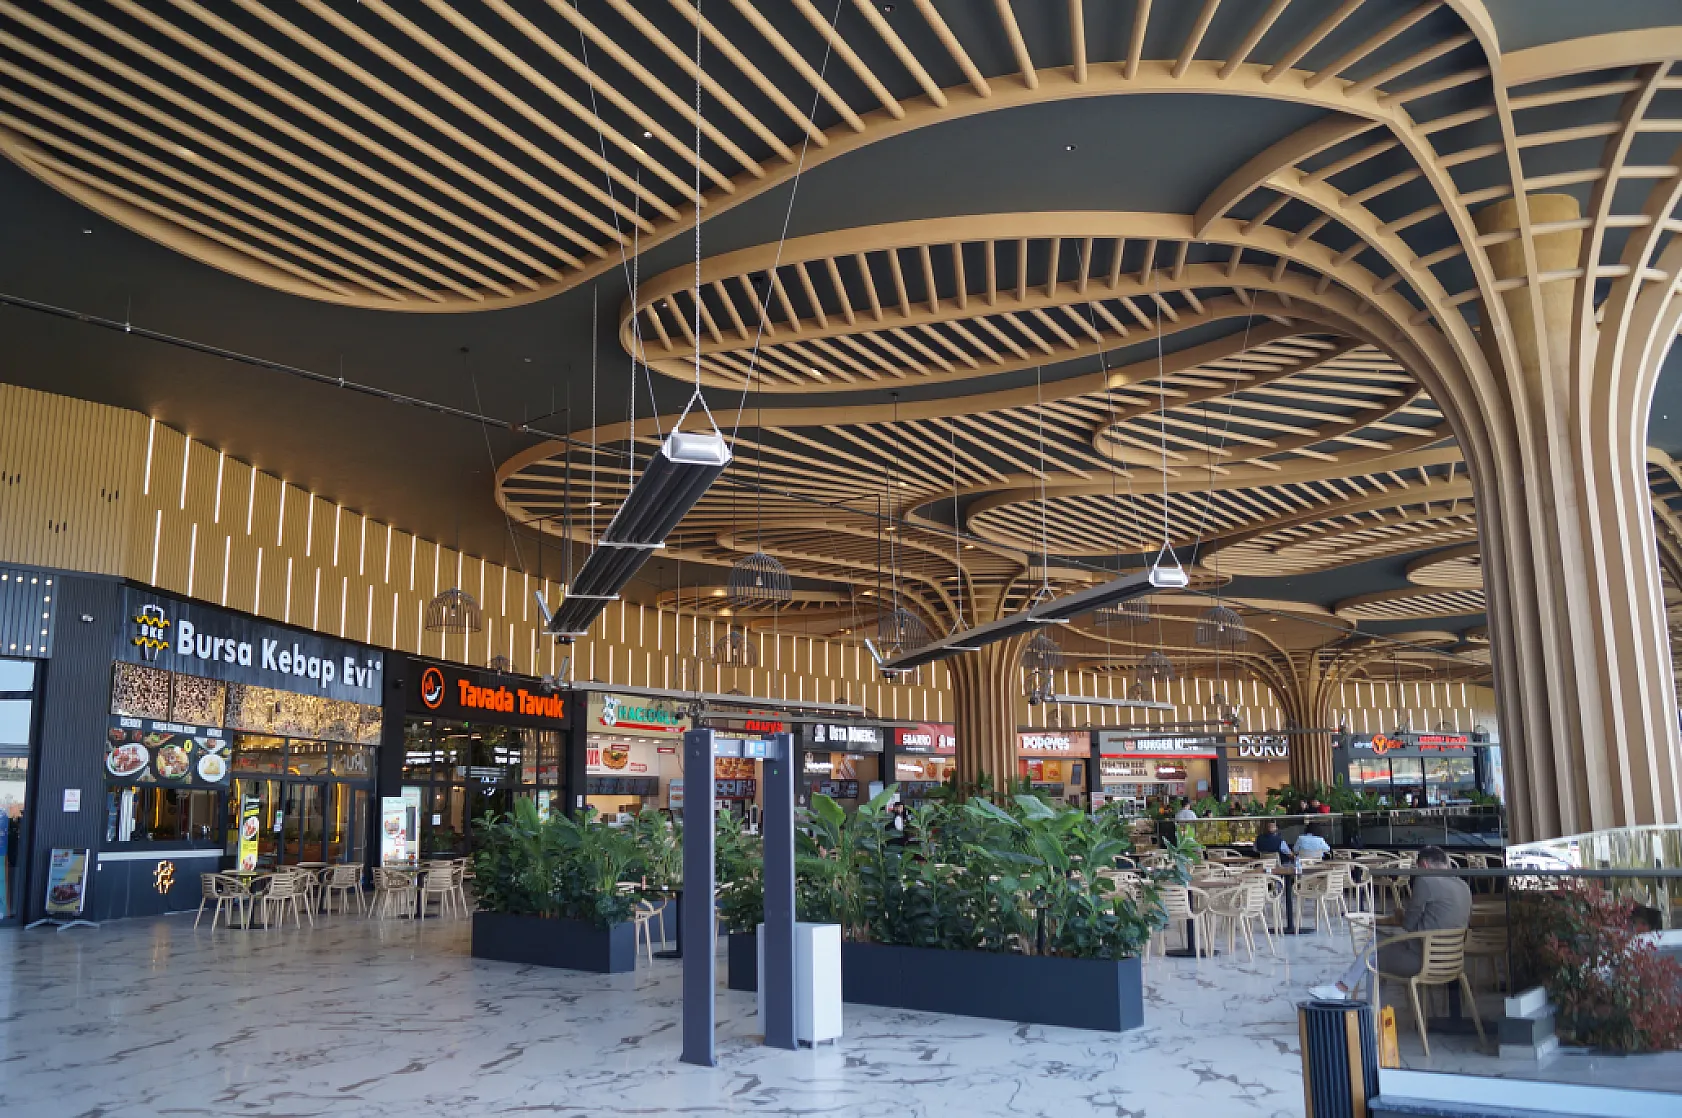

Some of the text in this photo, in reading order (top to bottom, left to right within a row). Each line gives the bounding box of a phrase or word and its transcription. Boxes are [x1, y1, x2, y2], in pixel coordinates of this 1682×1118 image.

[177, 620, 252, 667] Bursa
[261, 638, 334, 689] Kebap
[458, 679, 564, 719] Tavada Tavuk
